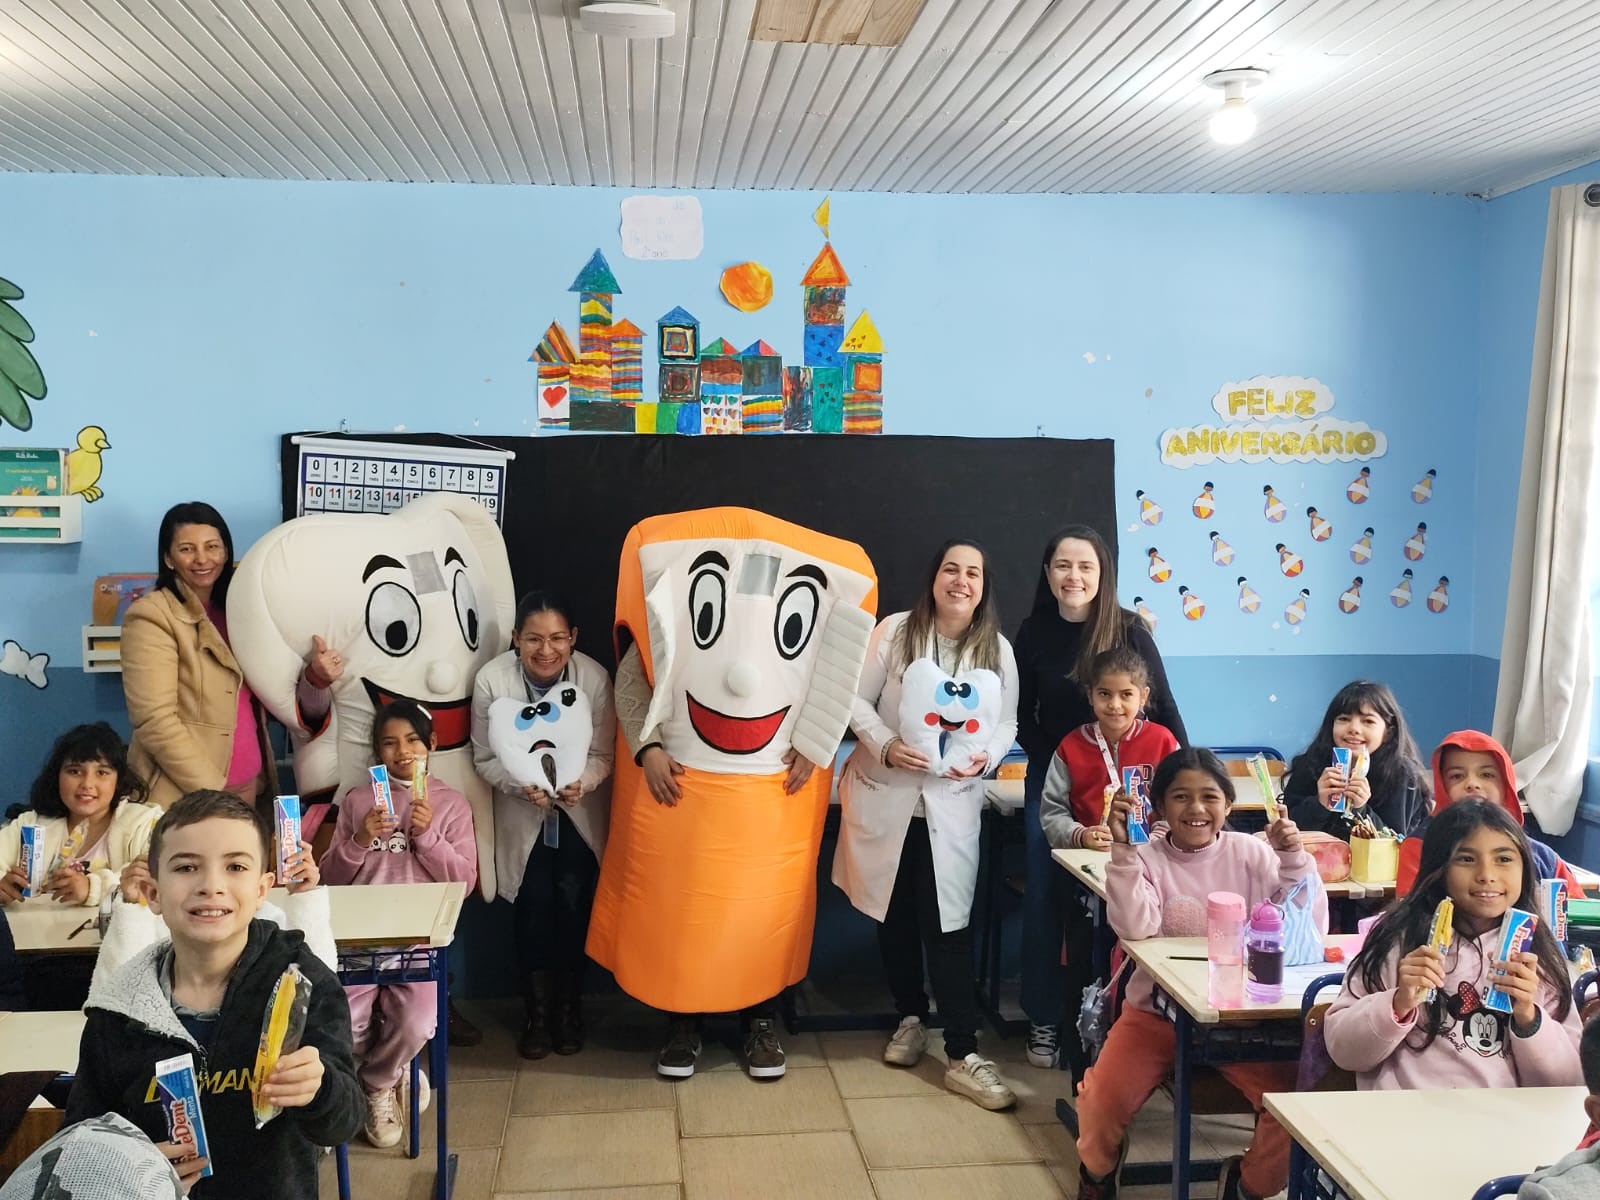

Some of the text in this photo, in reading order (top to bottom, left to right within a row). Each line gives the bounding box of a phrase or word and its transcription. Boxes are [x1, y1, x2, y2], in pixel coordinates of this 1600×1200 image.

[1228, 389, 1316, 416] FELIZ
[1166, 423, 1376, 457] ANIVERSÁRIO
[313, 460, 494, 482] 0 1 2 3 4 5 6 7 8 9
[309, 486, 322, 497] 10
[329, 488, 341, 498] 11
[347, 489, 360, 500] 12
[367, 490, 380, 501] 13
[386, 491, 400, 502] 14
[483, 498, 495, 508] 19
